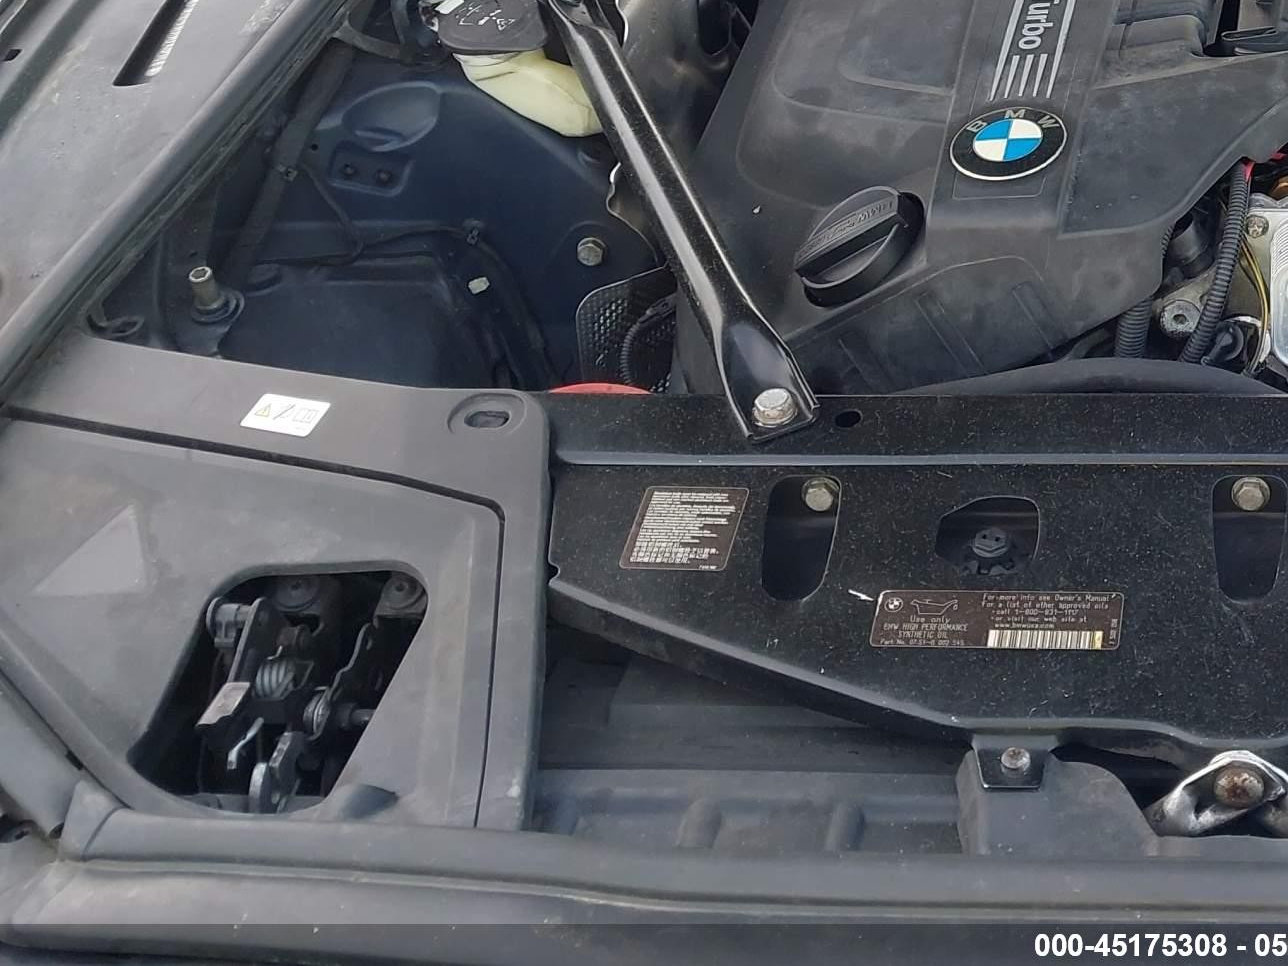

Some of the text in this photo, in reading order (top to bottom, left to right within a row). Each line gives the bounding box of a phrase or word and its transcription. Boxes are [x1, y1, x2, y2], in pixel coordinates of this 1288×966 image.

[966, 108, 1060, 133] BMW
[1085, 594, 1109, 602] Manual
[1058, 602, 1090, 611] approved
[910, 615, 951, 624] Use only
[902, 623, 918, 631] HIGH
[921, 623, 968, 631] PERFORMANCE
